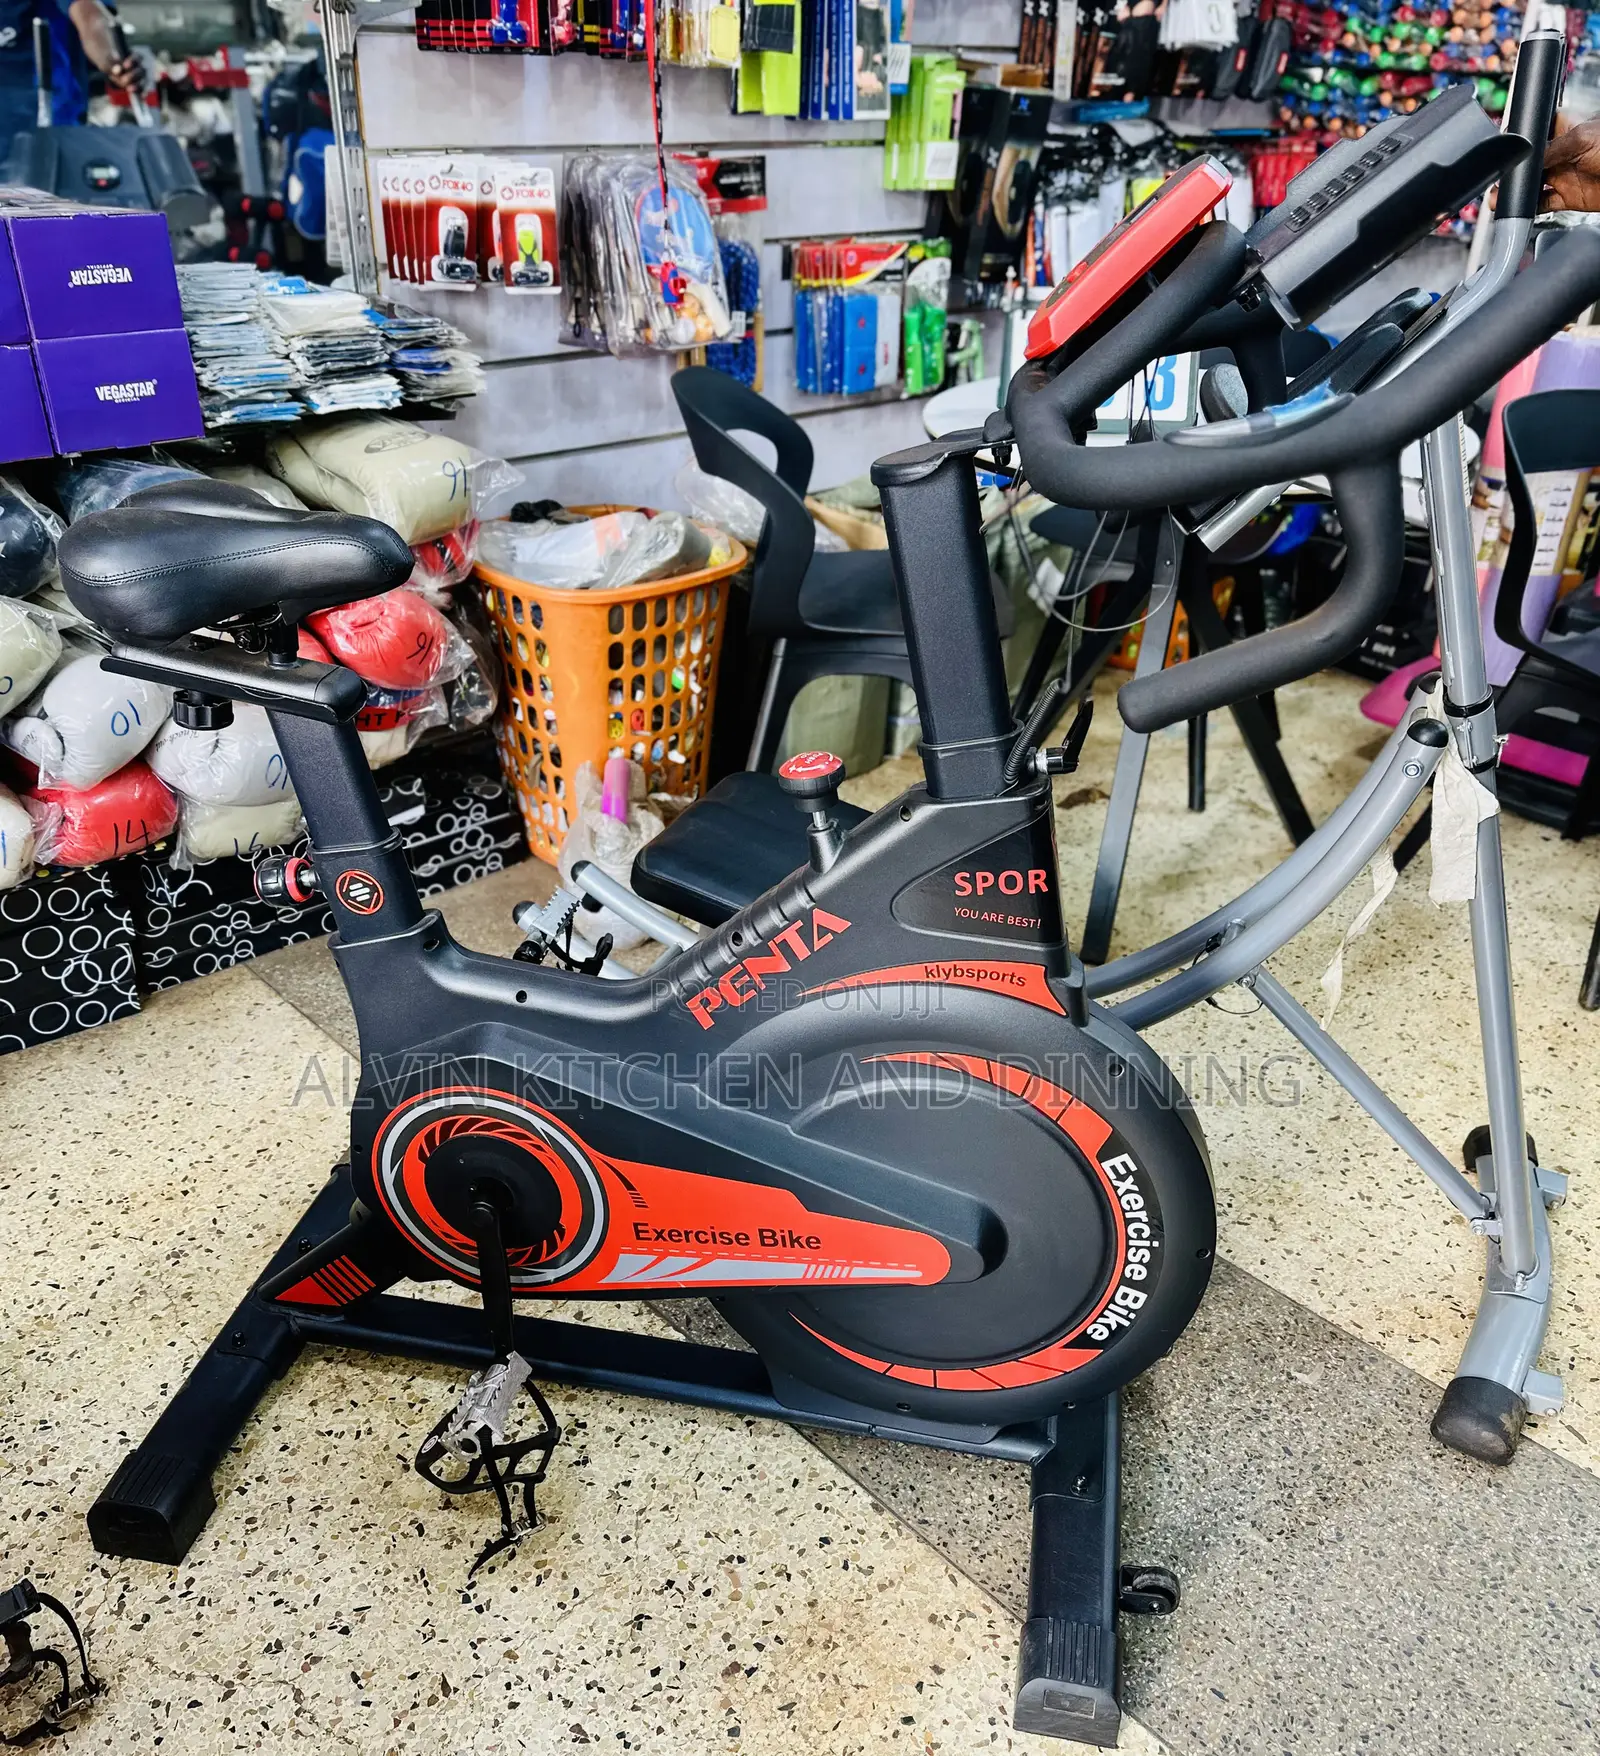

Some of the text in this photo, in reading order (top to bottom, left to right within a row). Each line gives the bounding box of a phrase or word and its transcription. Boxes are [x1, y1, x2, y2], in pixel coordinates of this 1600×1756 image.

[442, 179, 473, 191] FOX 40
[516, 188, 550, 198] FOX 40
[114, 818, 150, 856] 14
[954, 906, 1042, 929] YOU ARE BEST!
[685, 907, 852, 1031] PENTA
[924, 963, 1027, 987] klybsports
[632, 1222, 821, 1250] Exercise Bike
[1086, 1153, 1159, 1341] Exercise Bike
